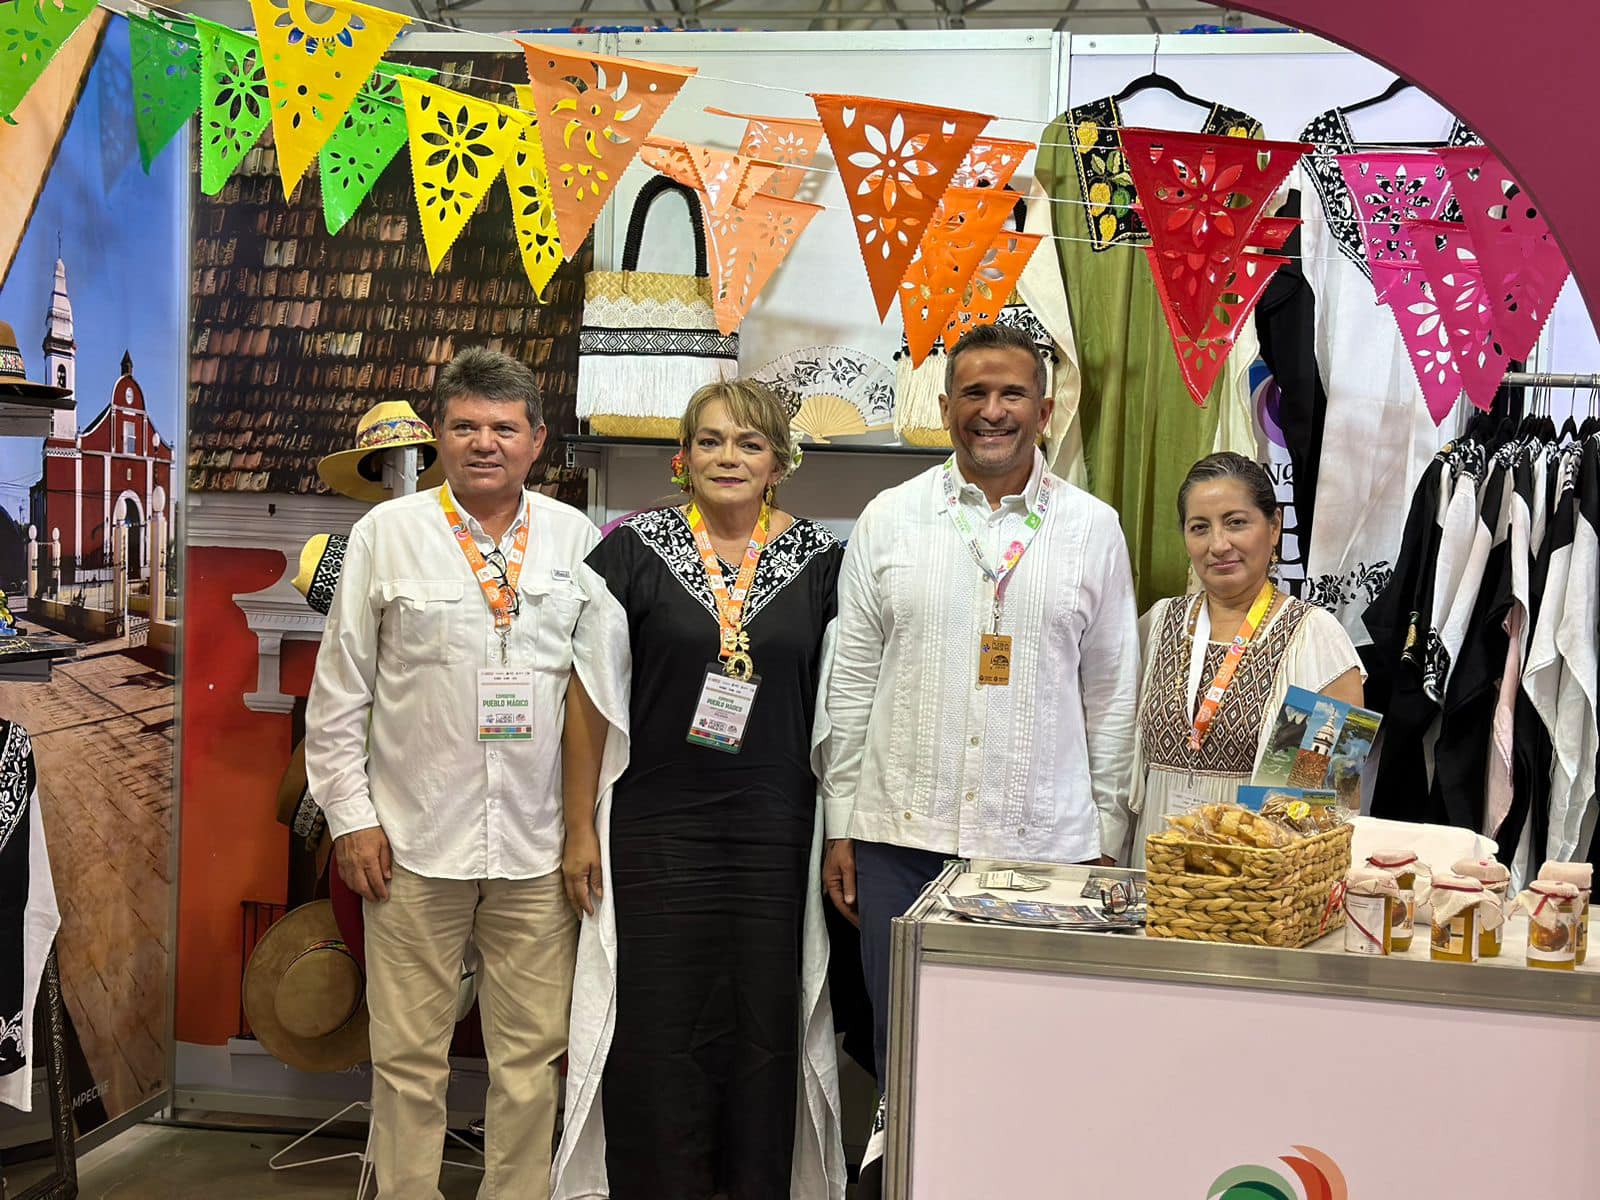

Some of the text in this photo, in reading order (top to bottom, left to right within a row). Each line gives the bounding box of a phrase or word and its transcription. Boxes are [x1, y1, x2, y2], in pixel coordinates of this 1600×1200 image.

[483, 698, 528, 707] PUEBLO MÁGICO
[706, 698, 725, 708] PUEBLO
[72, 1080, 112, 1111] MPECHE
